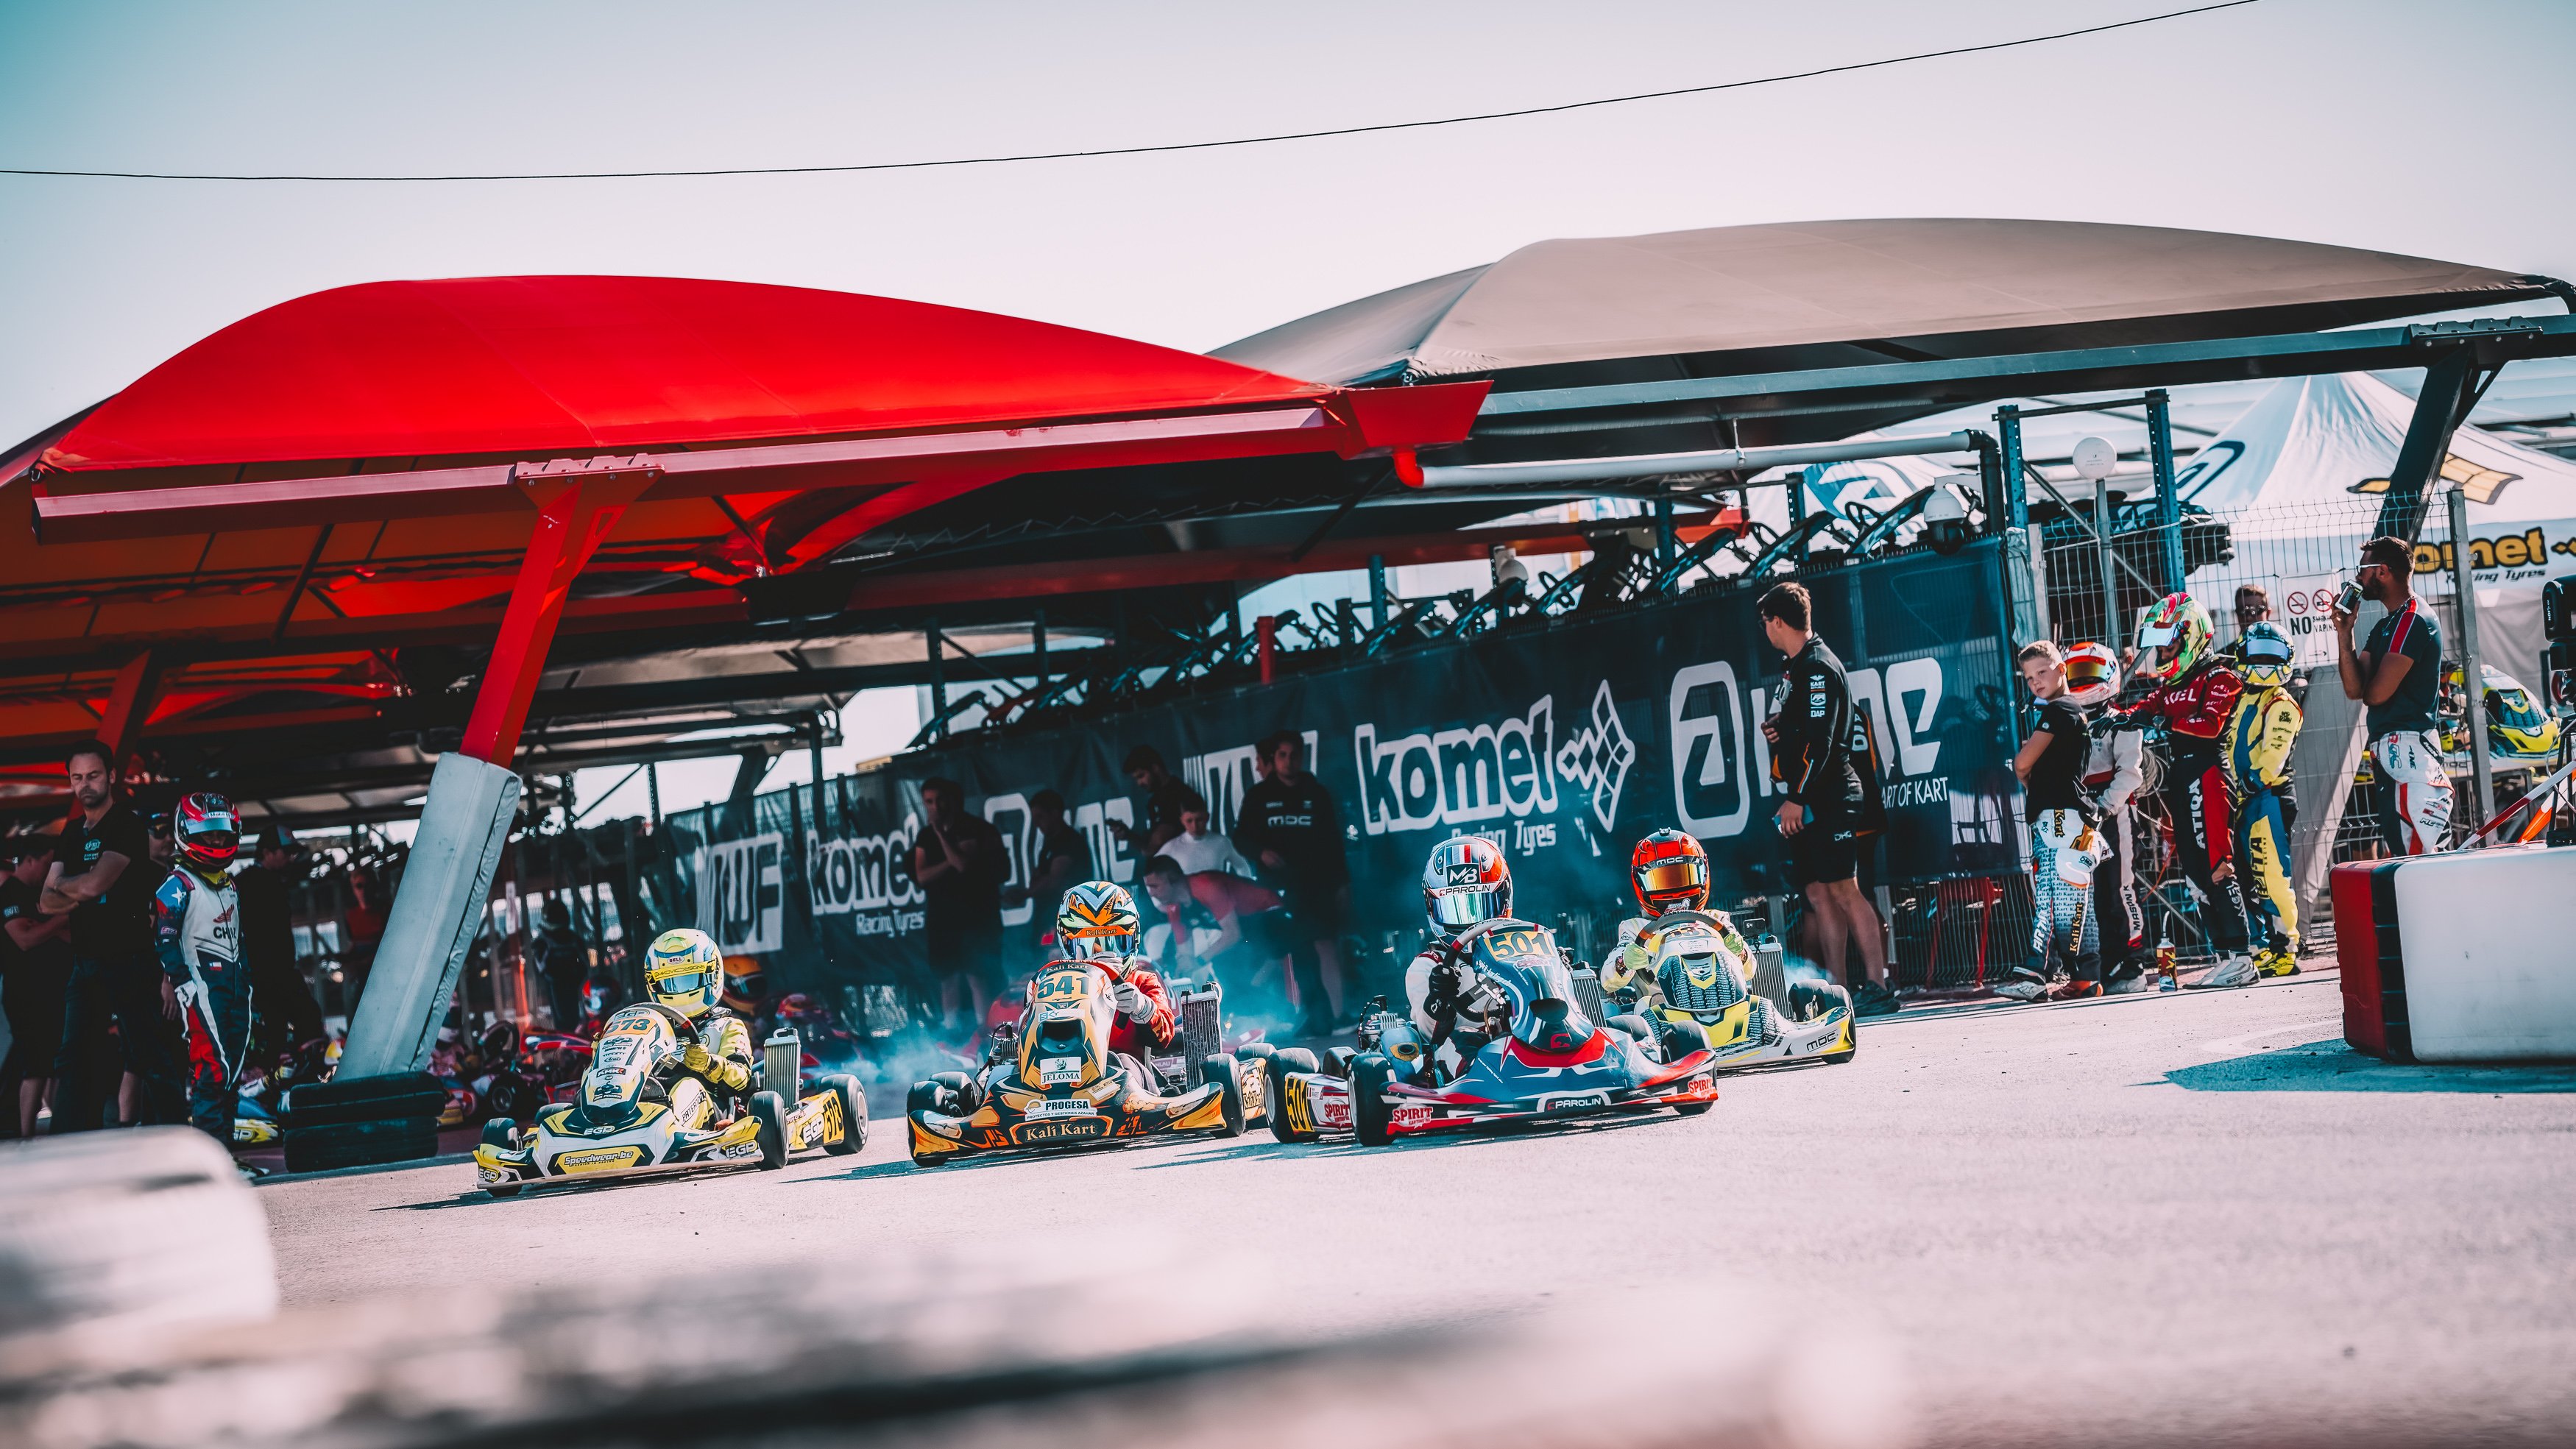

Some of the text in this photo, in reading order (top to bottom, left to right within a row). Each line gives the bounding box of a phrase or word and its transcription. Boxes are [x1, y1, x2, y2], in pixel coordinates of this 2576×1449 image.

[2505, 569, 2546, 580] Tyres
[2290, 617, 2311, 635] NO
[1355, 694, 1558, 835] komet
[1898, 782, 1912, 807] OF
[1915, 776, 1948, 804] KART
[1514, 820, 1556, 856] Tyres
[2079, 856, 2092, 868] OMP
[1446, 885, 1490, 896] PAROLIN
[2070, 902, 2084, 952] Kali Kart
[1489, 932, 1552, 957] 501
[1038, 976, 1089, 999] 541
[606, 1018, 650, 1034] 573
[1807, 1032, 1836, 1051] MDC
[1043, 1072, 1080, 1084] JELOMA
[1045, 1100, 1089, 1110] PROGESA
[1286, 1077, 1314, 1132] 501
[1325, 1104, 1350, 1118] SPIRIT
[1555, 1097, 1602, 1109] PAROLIN
[1393, 1106, 1433, 1122] SPIRIT
[583, 1125, 615, 1136] EGP
[803, 1116, 824, 1143] EGP
[1025, 1122, 1097, 1141] Kali Kart
[564, 1150, 633, 1166] Speedwear.be
[726, 1143, 757, 1158] EGP
[479, 1168, 498, 1181] EGP
